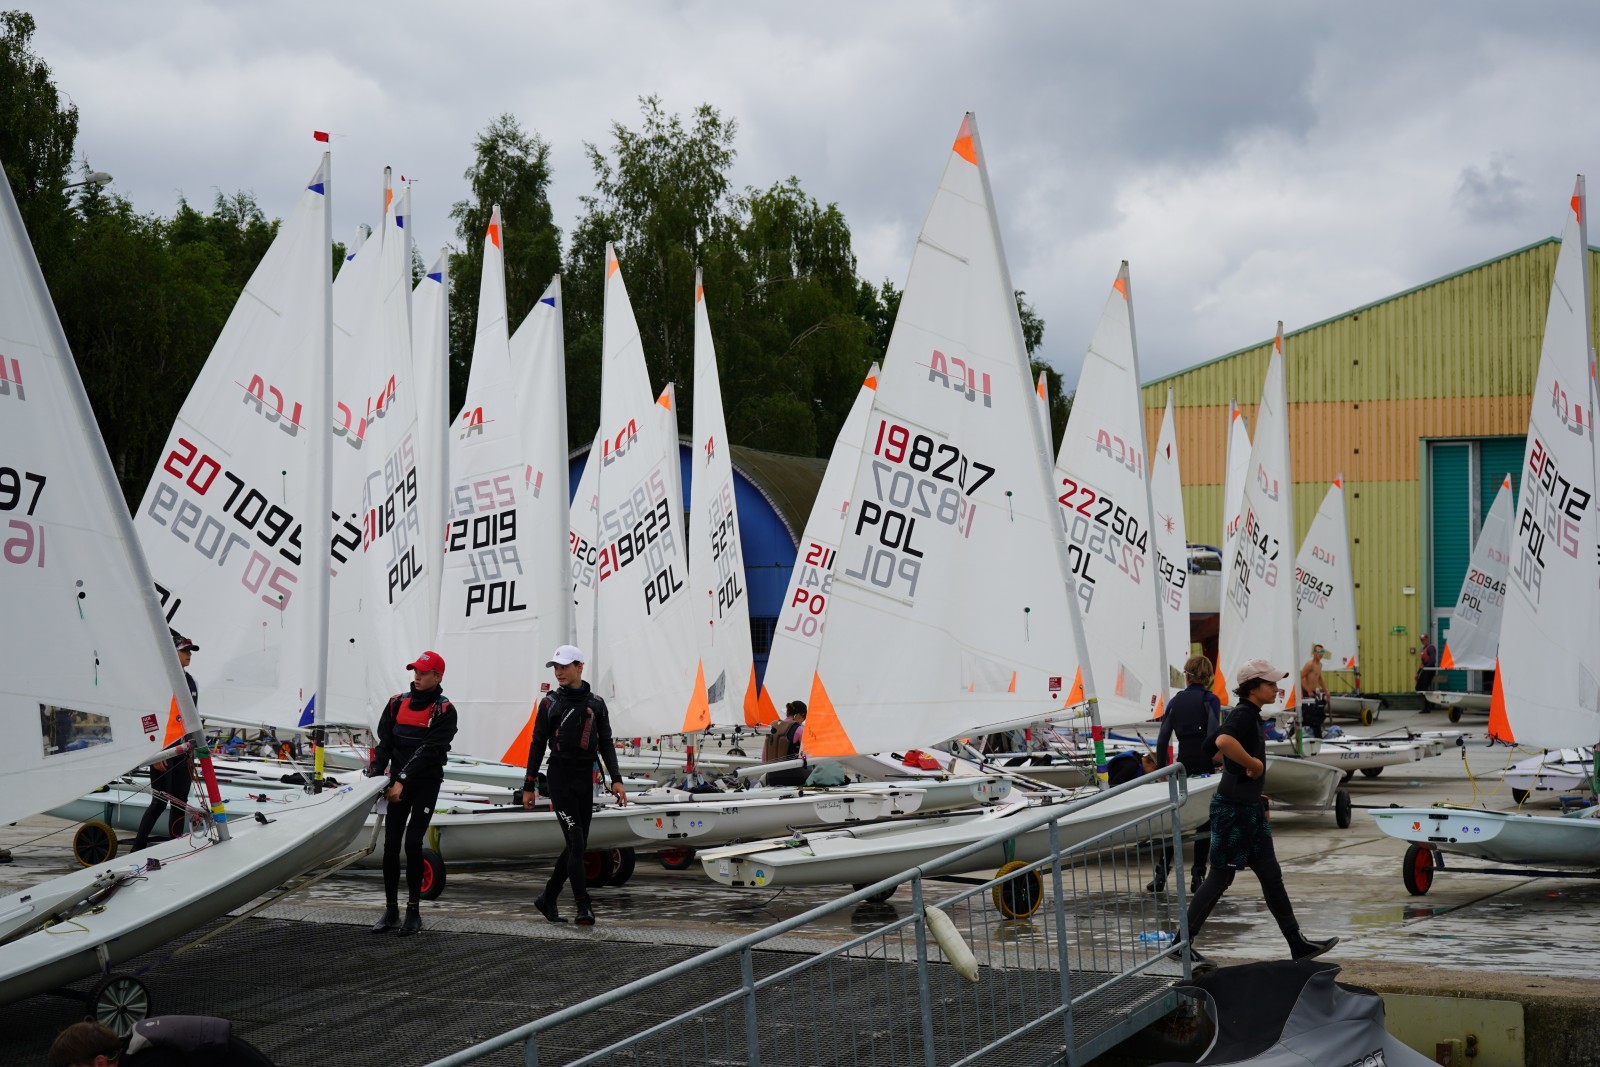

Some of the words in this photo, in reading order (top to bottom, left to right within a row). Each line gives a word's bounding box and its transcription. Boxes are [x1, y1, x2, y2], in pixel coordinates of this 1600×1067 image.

[603, 418, 638, 467] LCA
[874, 420, 995, 497] 198207
[1529, 438, 1591, 522] 215172
[363, 466, 417, 553] 211879
[444, 509, 517, 553] 2019
[855, 500, 923, 558] POL
[1058, 478, 1148, 555] 222504
[1246, 507, 1279, 561] 16647
[599, 498, 671, 582] 219623
[805, 543, 836, 570] 211
[1519, 507, 1545, 569] POL
[388, 545, 423, 604] POL
[1068, 544, 1096, 584] OL
[1234, 550, 1251, 595] POL
[1295, 567, 1333, 597] 210943
[1469, 569, 1507, 596] 20946
[465, 580, 527, 617] POL
[644, 565, 683, 615] POL
[718, 571, 743, 618] POL
[792, 588, 825, 615] PO
[1461, 592, 1482, 613] POL
